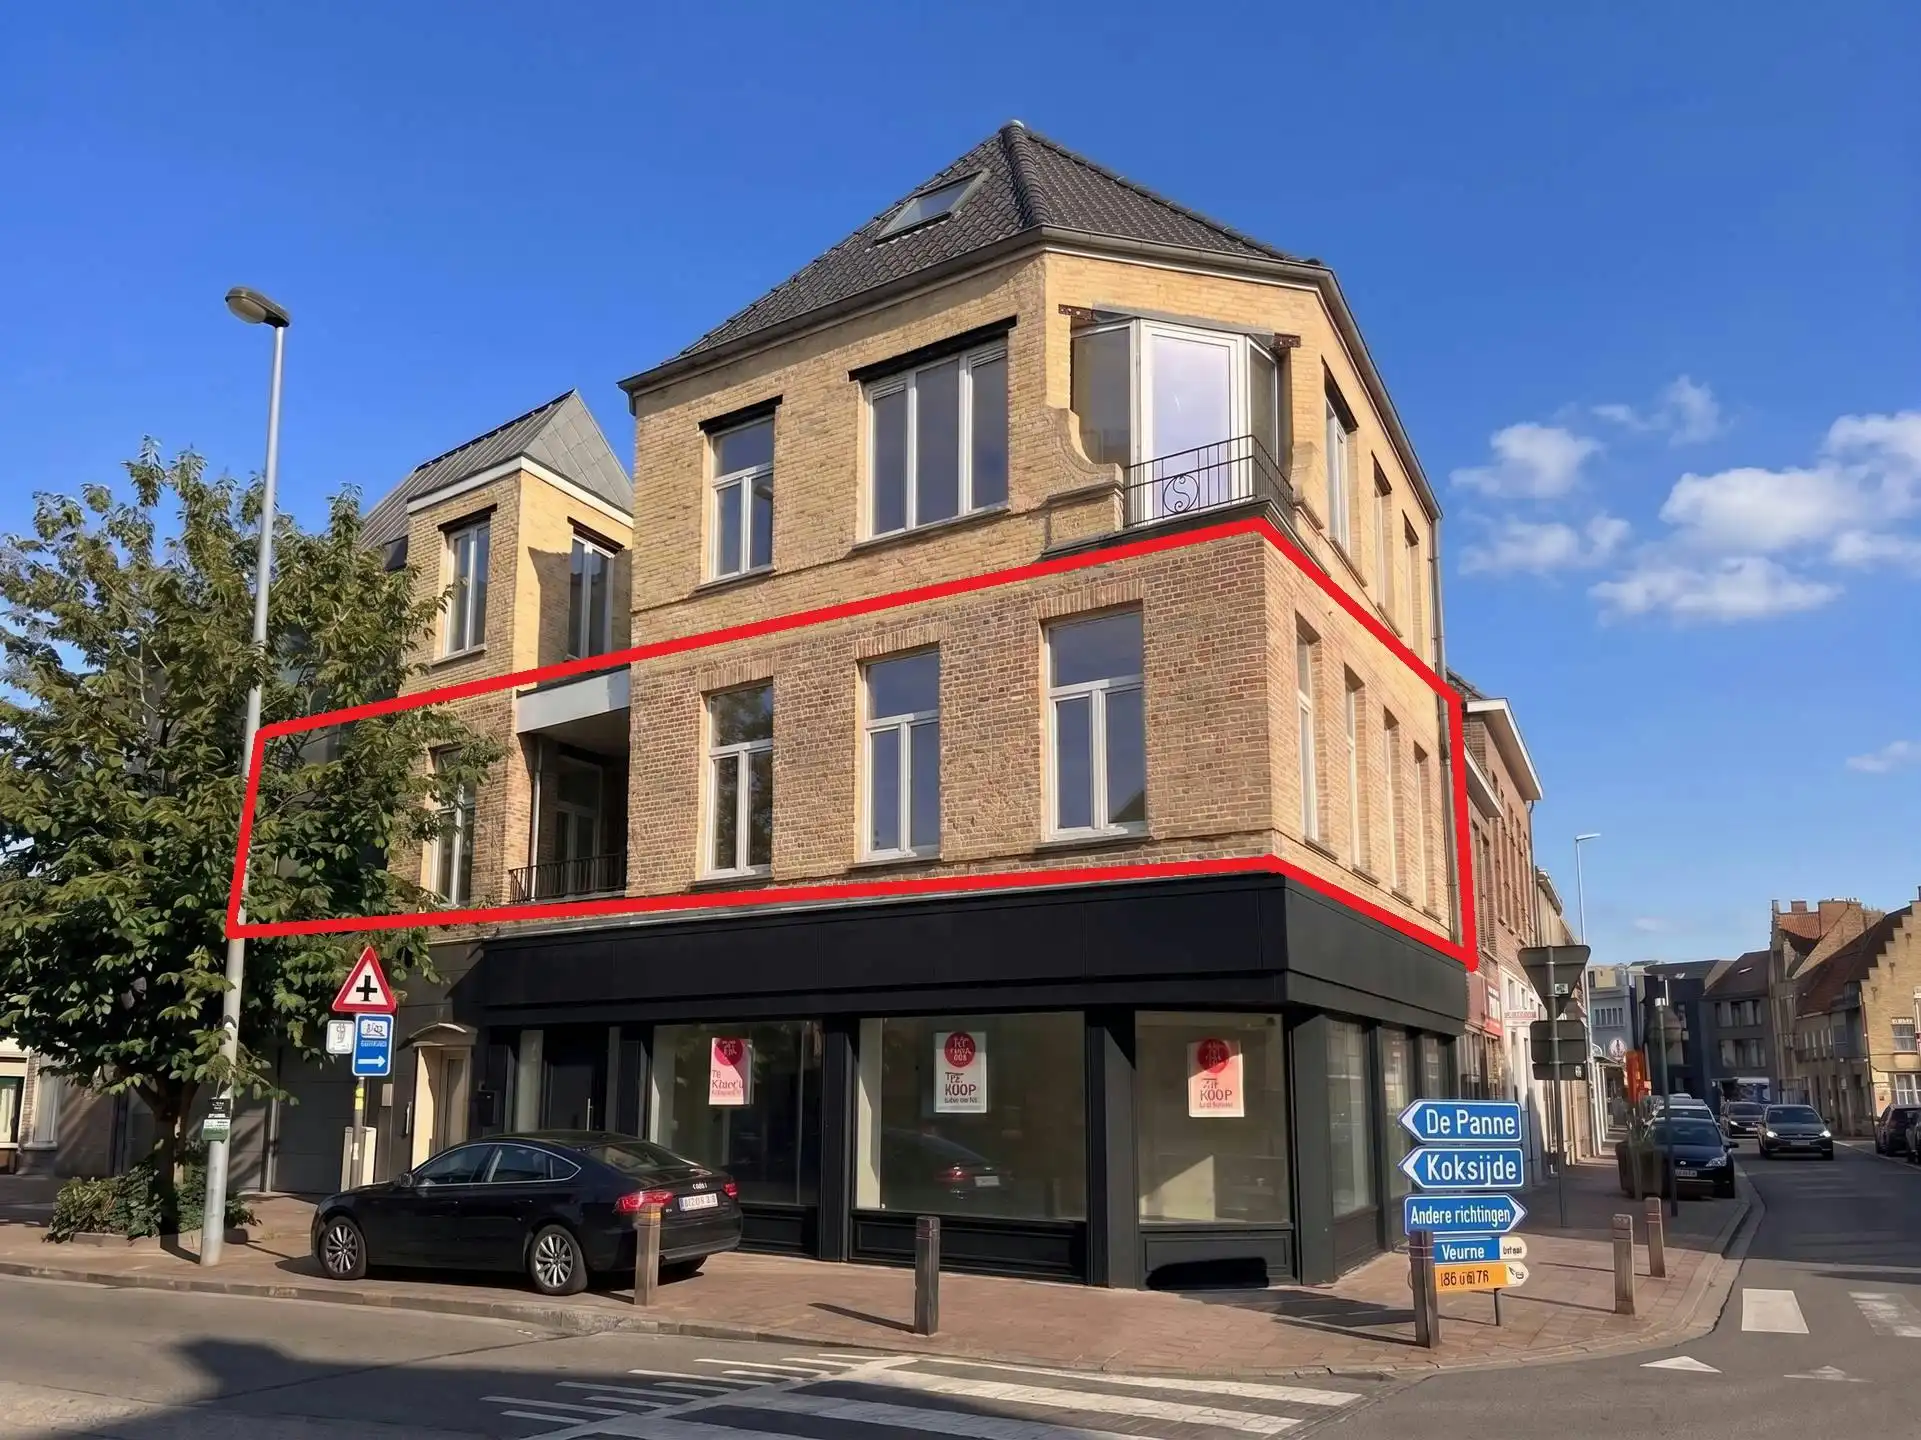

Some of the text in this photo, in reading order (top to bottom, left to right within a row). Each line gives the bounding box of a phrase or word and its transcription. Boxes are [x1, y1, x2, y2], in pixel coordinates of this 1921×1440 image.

[945, 1084, 977, 1096] KOOP
[1200, 1089, 1233, 1101] KOOP
[1426, 1108, 1515, 1136] De Panne
[1427, 1154, 1517, 1185] Koksijde
[1410, 1205, 1511, 1228] Andere richtingen
[1441, 1244, 1485, 1261] Veurne
